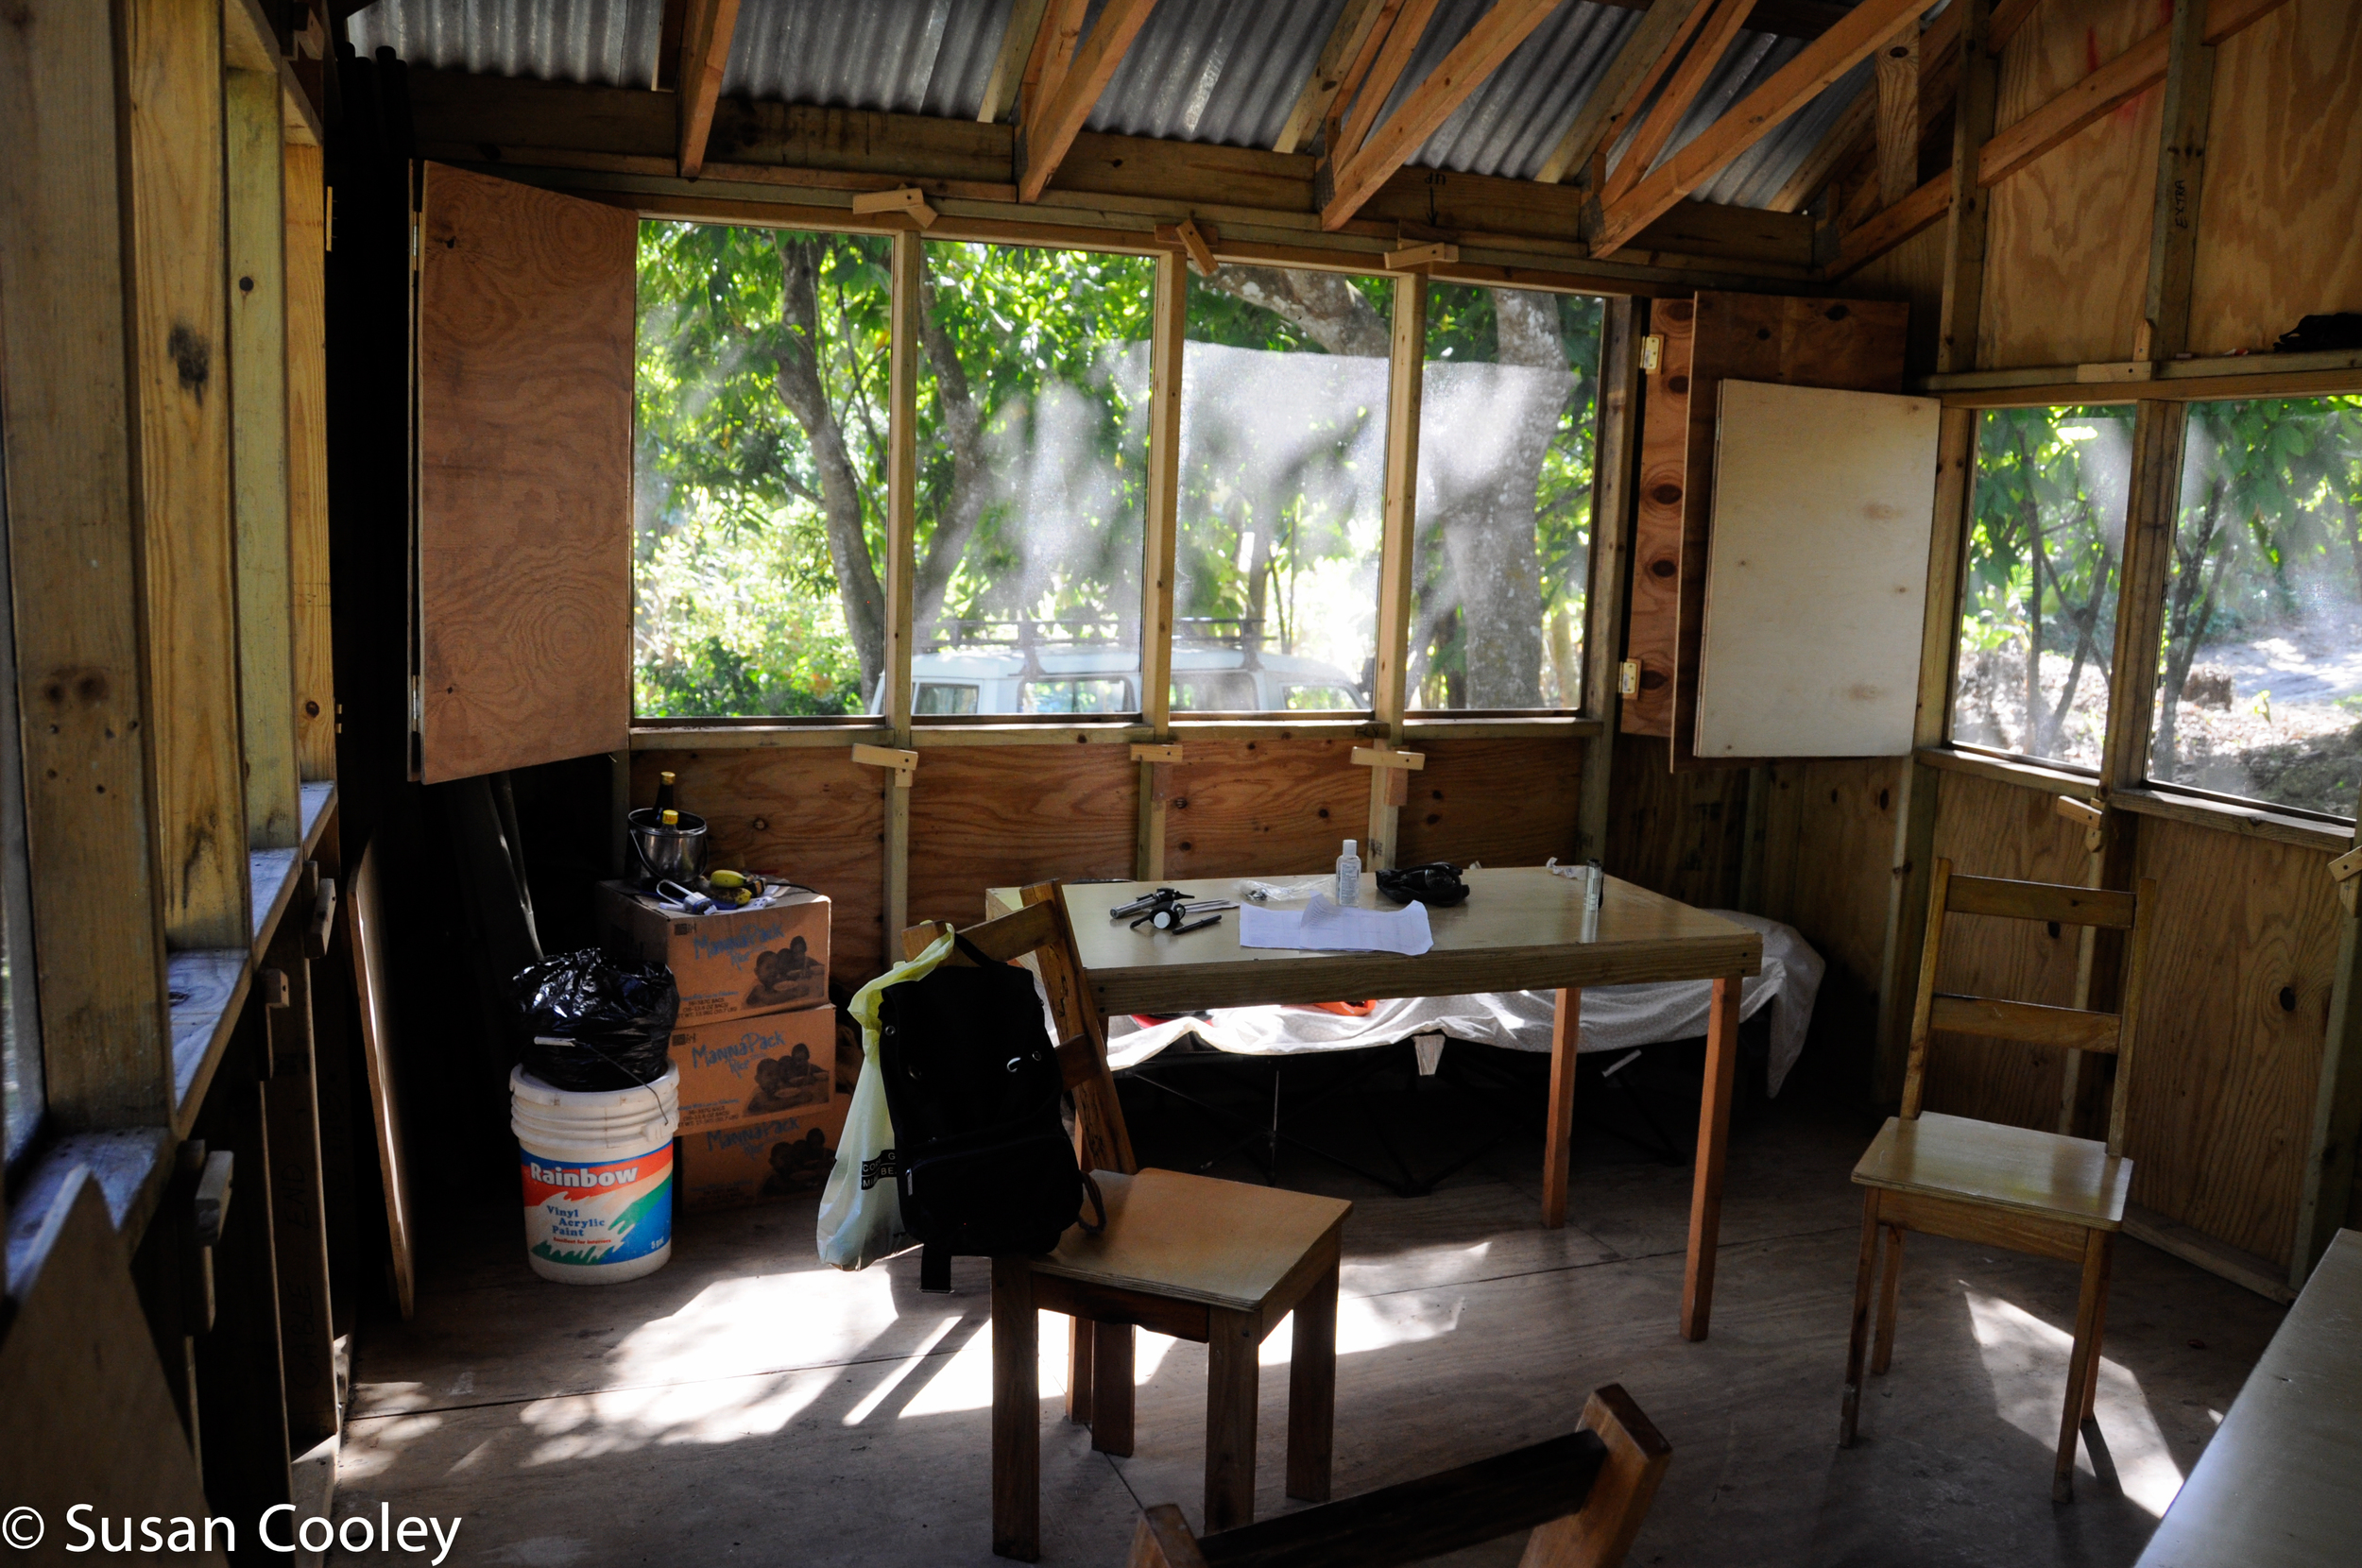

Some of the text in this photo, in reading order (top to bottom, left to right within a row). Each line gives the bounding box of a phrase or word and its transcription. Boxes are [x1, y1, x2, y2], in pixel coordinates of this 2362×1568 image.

[2174, 179, 2188, 229] EXTRA
[530, 1162, 638, 1187] Rainbow
[547, 1205, 579, 1219] Vinyl
[553, 1225, 585, 1236] Paint
[558, 1219, 605, 1229] Acrylic
[282, 1164, 320, 1389] GABLE END
